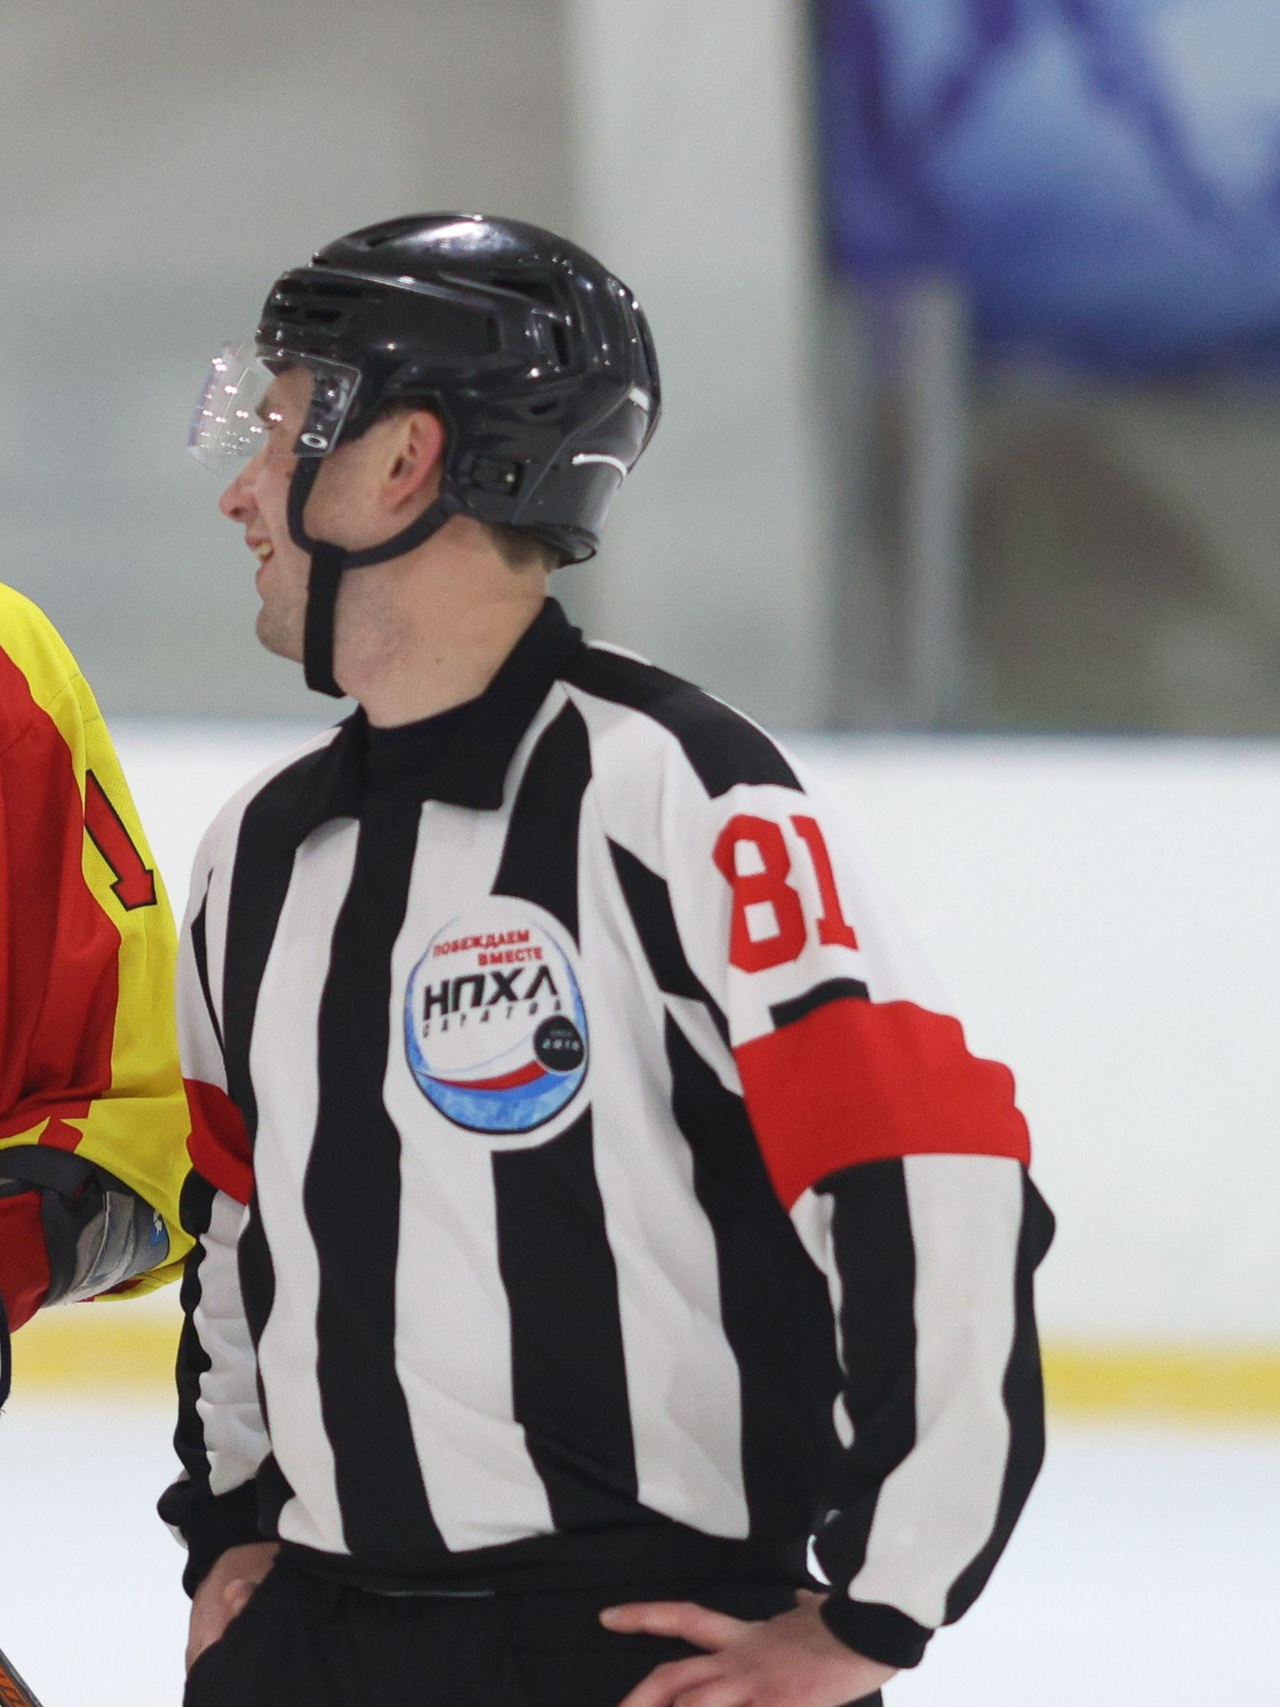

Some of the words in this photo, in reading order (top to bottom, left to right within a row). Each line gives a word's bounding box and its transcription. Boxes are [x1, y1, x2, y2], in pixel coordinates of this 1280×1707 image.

[712, 814, 859, 975] 81
[433, 930, 530, 958] ПОБЕЖДАЕМ
[478, 947, 542, 966] ВМЕСТЕ
[423, 965, 558, 1021] НПХЛ
